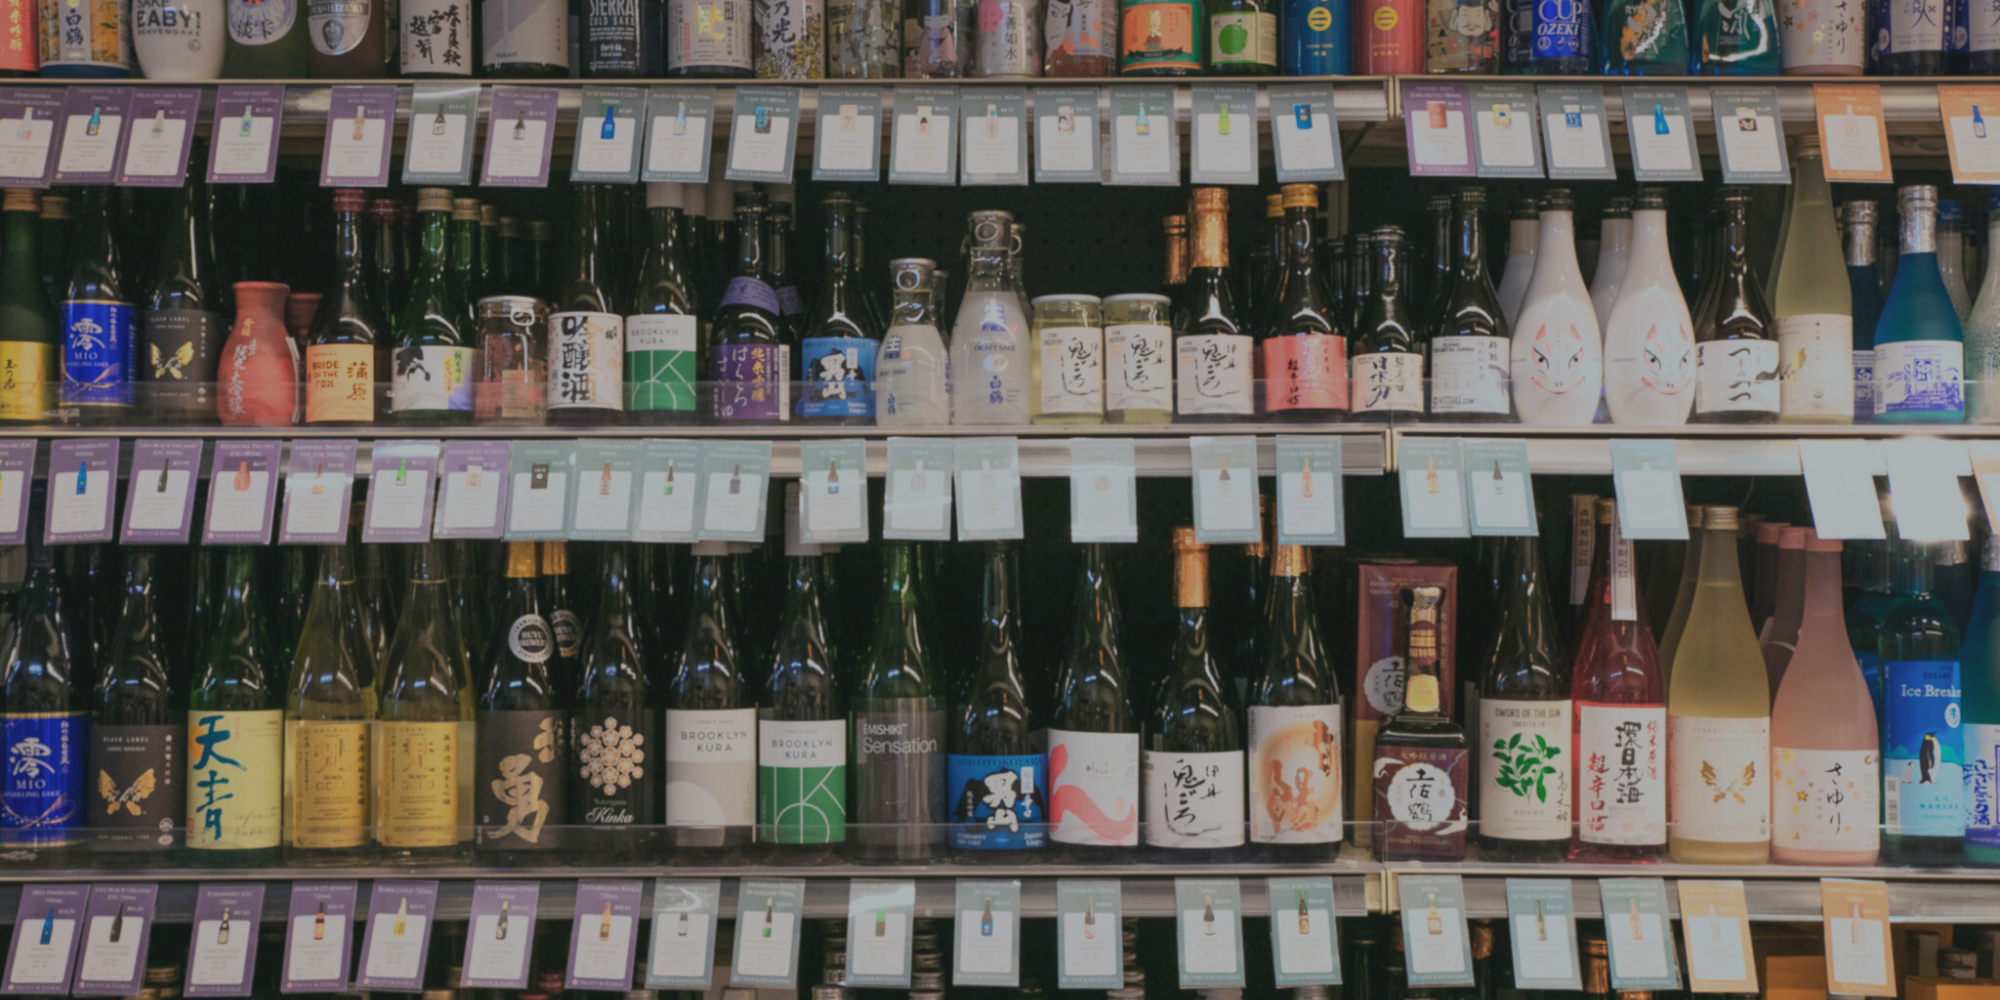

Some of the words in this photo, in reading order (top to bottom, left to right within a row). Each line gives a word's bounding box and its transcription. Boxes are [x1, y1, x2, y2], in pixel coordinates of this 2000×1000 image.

[590, 0, 635, 17] SIERRA
[1539, 0, 1582, 23] CUP
[65, 8, 84, 46] 白鶴
[590, 17, 608, 26] COLD
[613, 17, 636, 26] SAKE
[1004, 2, 1019, 61] 上善如水
[1537, 23, 1579, 35] OZEKI
[631, 328, 679, 337] BROOKLYN
[640, 337, 665, 345] KURA
[816, 340, 867, 348] OTOKOYAMA
[973, 344, 998, 352] DRAFT
[999, 344, 1017, 352] SAKE
[74, 352, 98, 360] MIO
[312, 360, 340, 370] BRIDE
[313, 372, 323, 380] OF
[324, 371, 339, 379] THE
[315, 380, 335, 389] FOX
[346, 360, 368, 403] 蒲原
[1365, 356, 1391, 408] 日本刀
[989, 375, 1003, 405] 白鶴
[1901, 684, 1922, 697] Ice
[1494, 708, 1519, 718] SWORD
[1522, 708, 1532, 718] OF
[1533, 708, 1547, 719] THE
[1548, 709, 1561, 719] SUN
[681, 730, 748, 740] BROOKLYN
[696, 743, 733, 753] KURA
[771, 739, 832, 749] BROOKLYN
[863, 736, 937, 753] Sensation
[785, 750, 817, 759] KURA
[1645, 719, 1659, 781] 純米原酒
[976, 756, 1043, 767] OTOKOYAMA
[1614, 720, 1645, 805] 環日本海
[16, 779, 46, 790] MIO
[194, 715, 248, 843] 天青
[41, 789, 60, 797] SAKE
[1405, 767, 1436, 823] 土佐鶴
[1824, 762, 1844, 836] さゆり
[585, 806, 636, 824] Kinka
